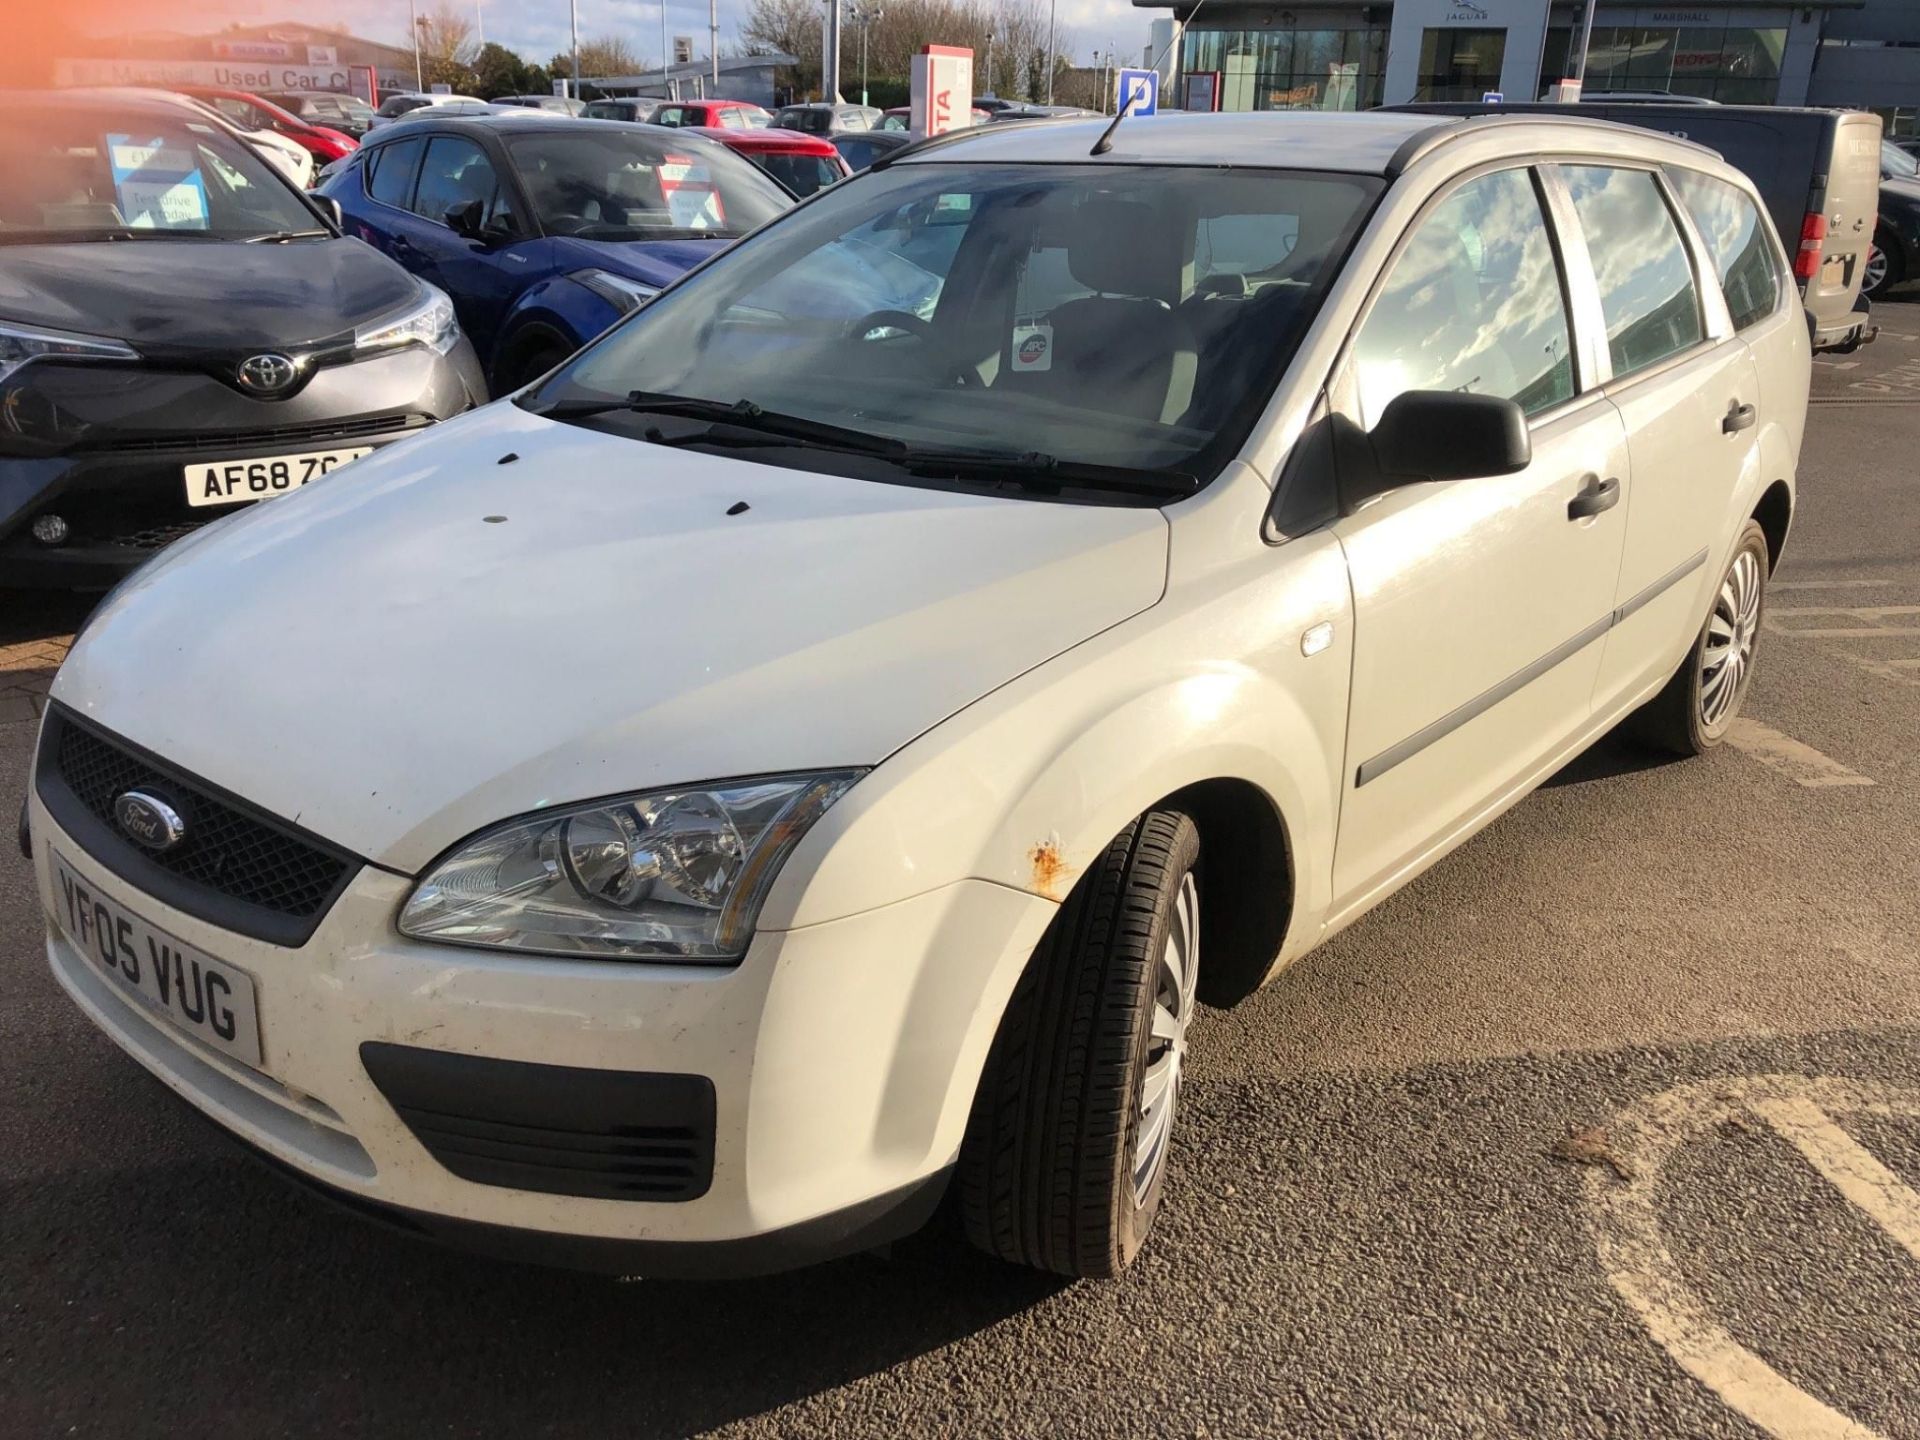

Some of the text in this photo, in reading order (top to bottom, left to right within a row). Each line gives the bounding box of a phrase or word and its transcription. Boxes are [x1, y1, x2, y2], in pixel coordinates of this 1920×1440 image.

[215, 69, 271, 87] Used
[282, 70, 319, 89] Car
[330, 71, 399, 89] Cre
[203, 461, 290, 498] AF68
[124, 802, 157, 840] Ford
[147, 934, 237, 1043] VUG
